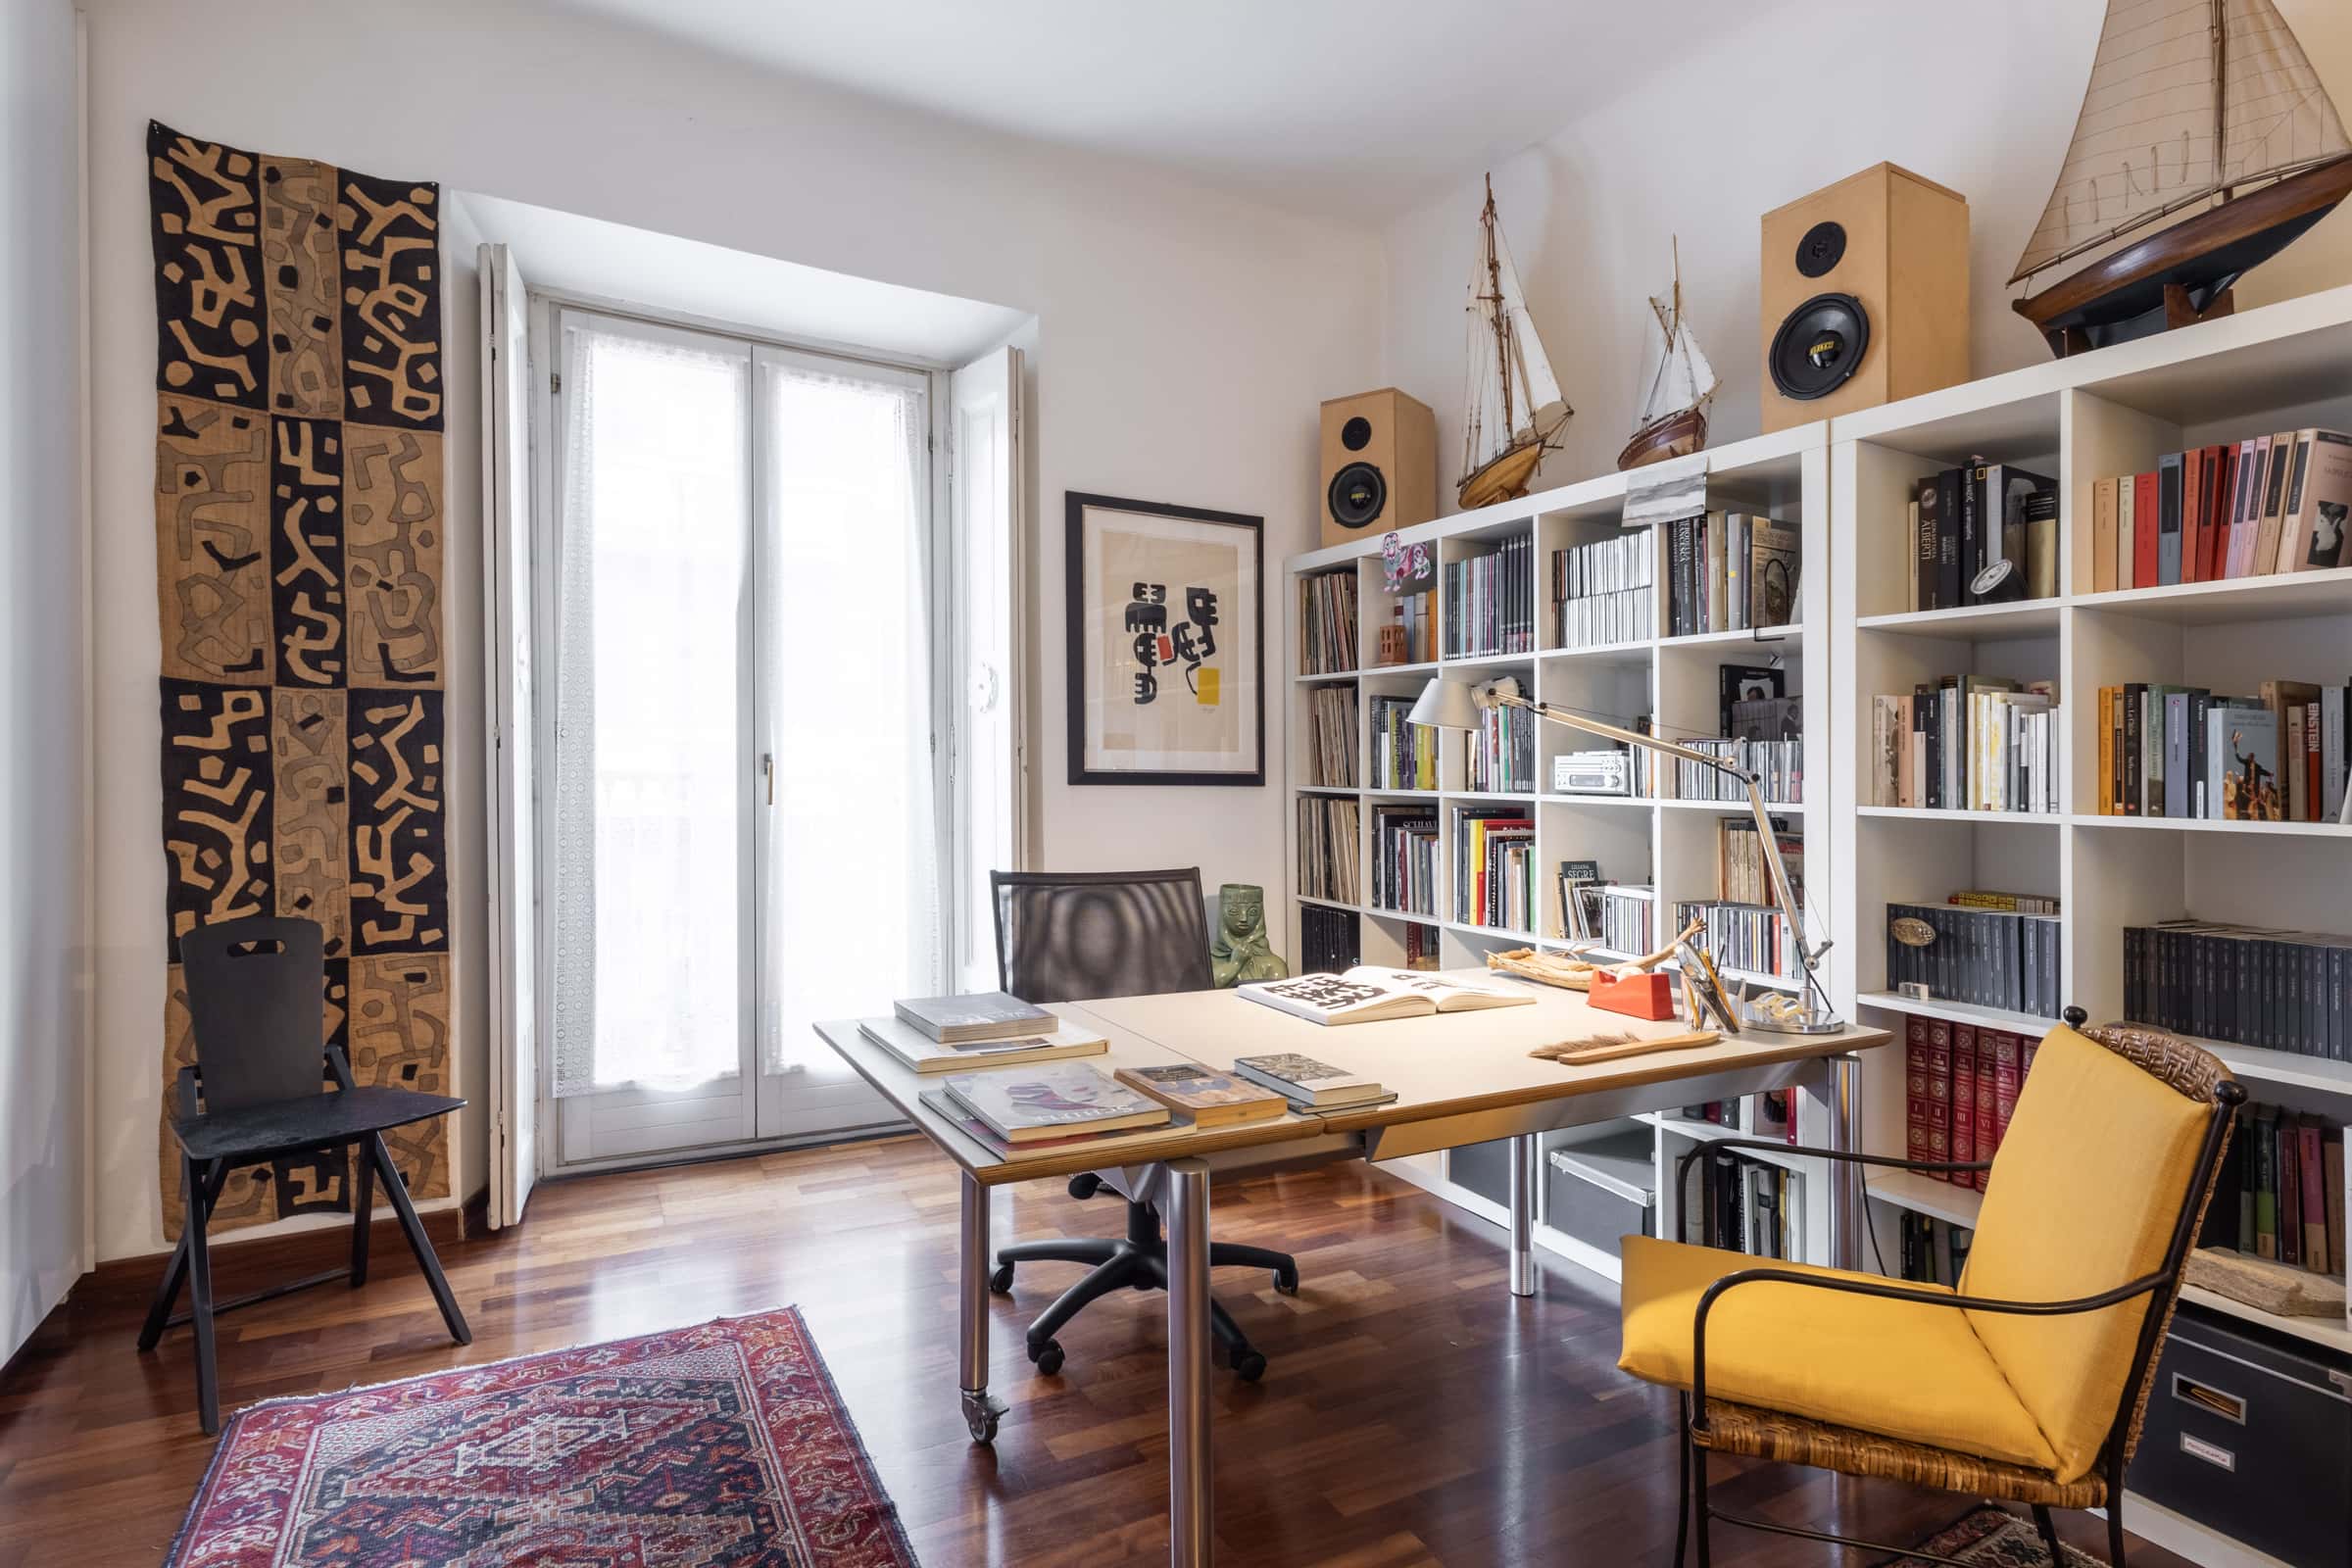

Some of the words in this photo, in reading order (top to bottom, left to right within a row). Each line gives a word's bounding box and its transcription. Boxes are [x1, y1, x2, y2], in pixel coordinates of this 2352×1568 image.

[1921, 519, 1931, 561] ALBERTI
[2308, 703, 2320, 752] EINSTEIN
[1568, 869, 1594, 879] SEGRE
[1957, 1112, 1966, 1122] III
[1981, 1120, 1990, 1129] VI
